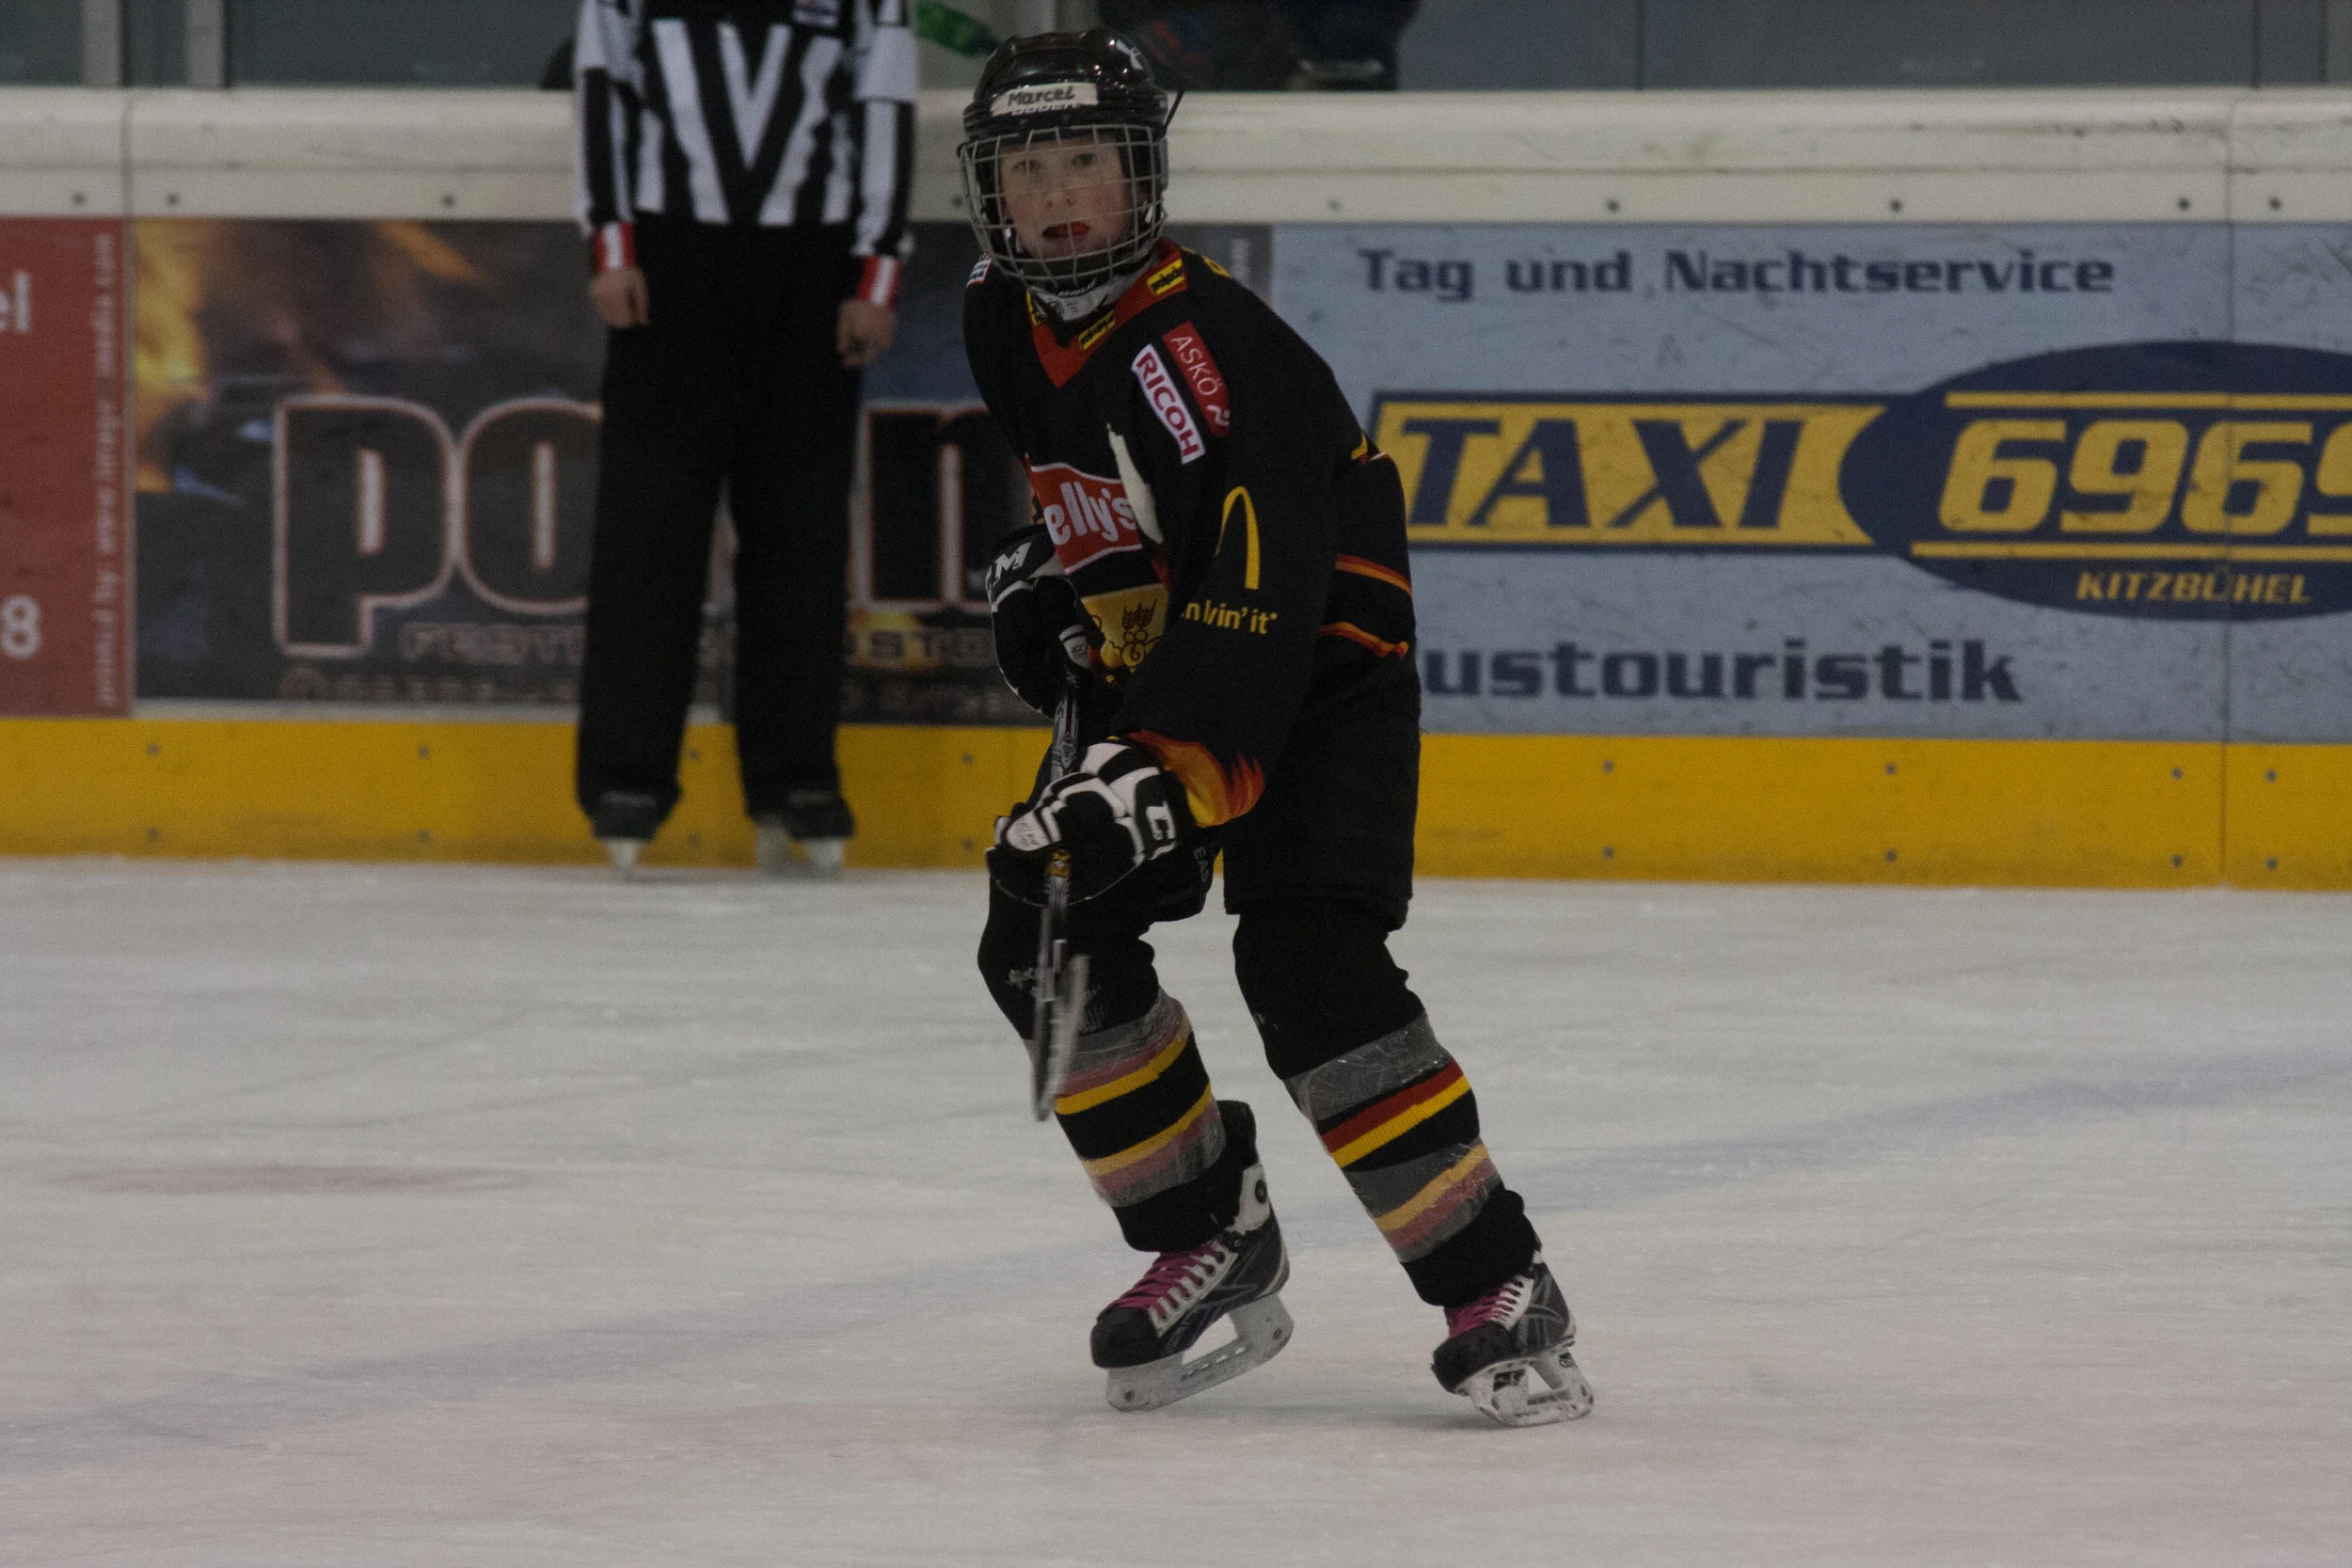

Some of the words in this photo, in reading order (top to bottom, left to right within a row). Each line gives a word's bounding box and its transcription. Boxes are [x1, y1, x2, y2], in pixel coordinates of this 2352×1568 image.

[1008, 86, 1075, 107] Marcel
[1359, 249, 1474, 302] Tag
[1508, 250, 1631, 293] und
[1665, 250, 2114, 293] Nachtservice
[1170, 335, 1223, 396] ASKÖ
[1135, 352, 1200, 456] RICOH
[1401, 417, 1809, 530] TAXI
[2075, 566, 2312, 605] KITZBÜHEL
[1423, 639, 2022, 703] ustouristik
